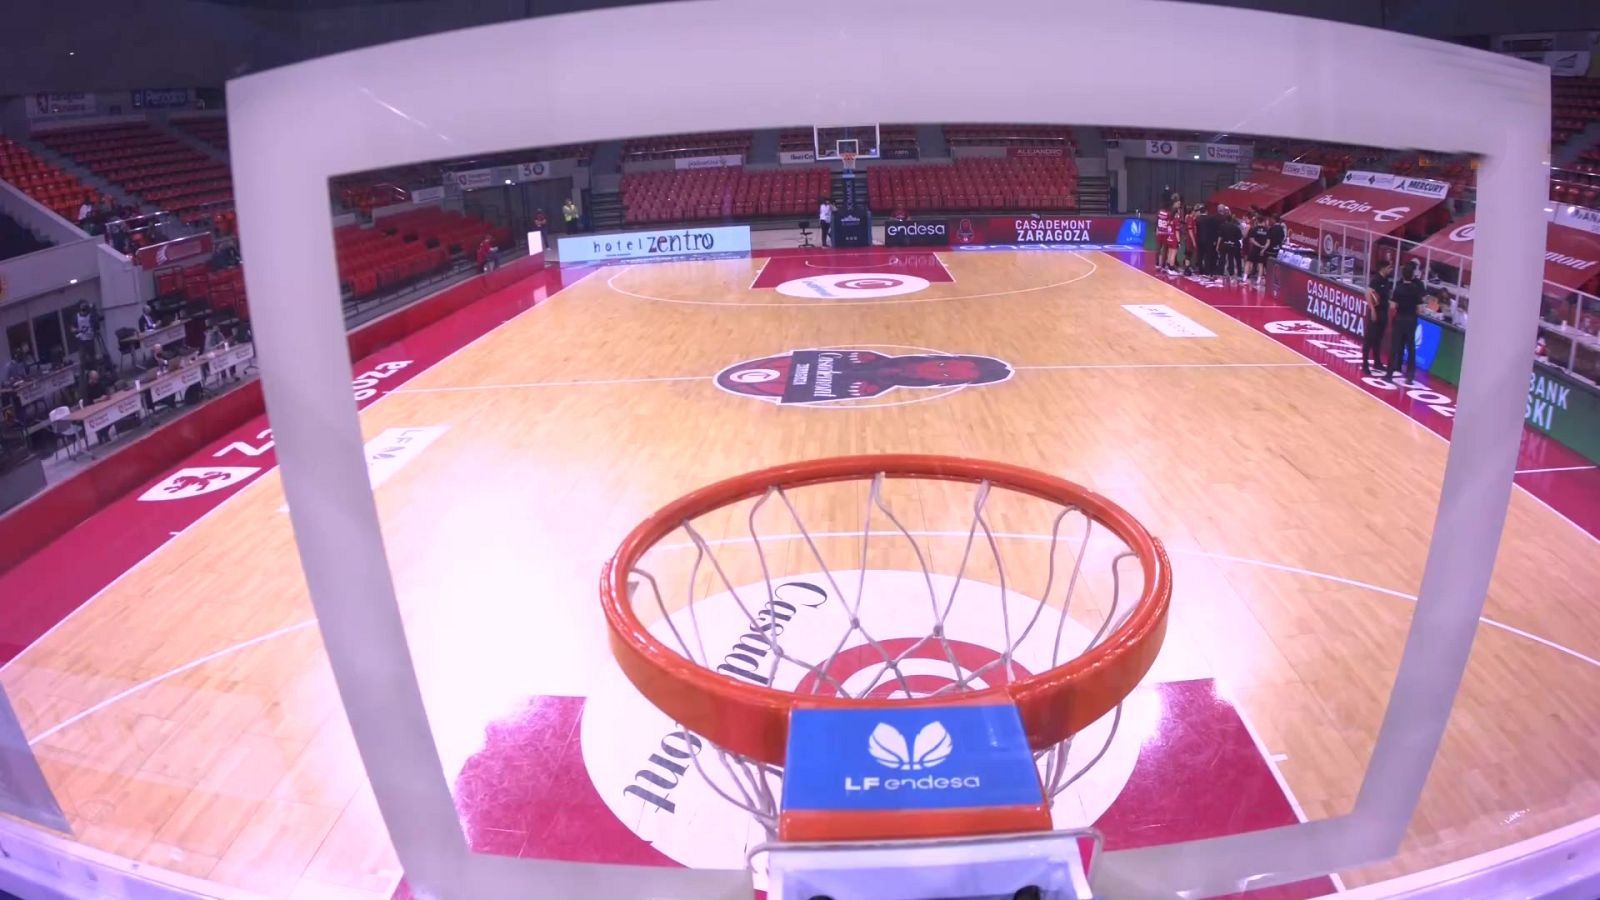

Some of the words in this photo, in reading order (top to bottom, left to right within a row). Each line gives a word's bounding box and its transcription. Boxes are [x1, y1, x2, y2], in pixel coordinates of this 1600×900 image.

[1407, 180, 1445, 193] MERCURY
[887, 222, 945, 236] endesa
[1015, 219, 1092, 231] CASADEMONT
[593, 238, 643, 253] hotel
[648, 230, 714, 254] zentro
[1016, 229, 1091, 242] ZARAGOZA
[1306, 279, 1369, 317] CASADEMONT
[1306, 296, 1365, 337] ZARAGOZA
[844, 777, 881, 791] LF
[884, 774, 981, 791] endesa
